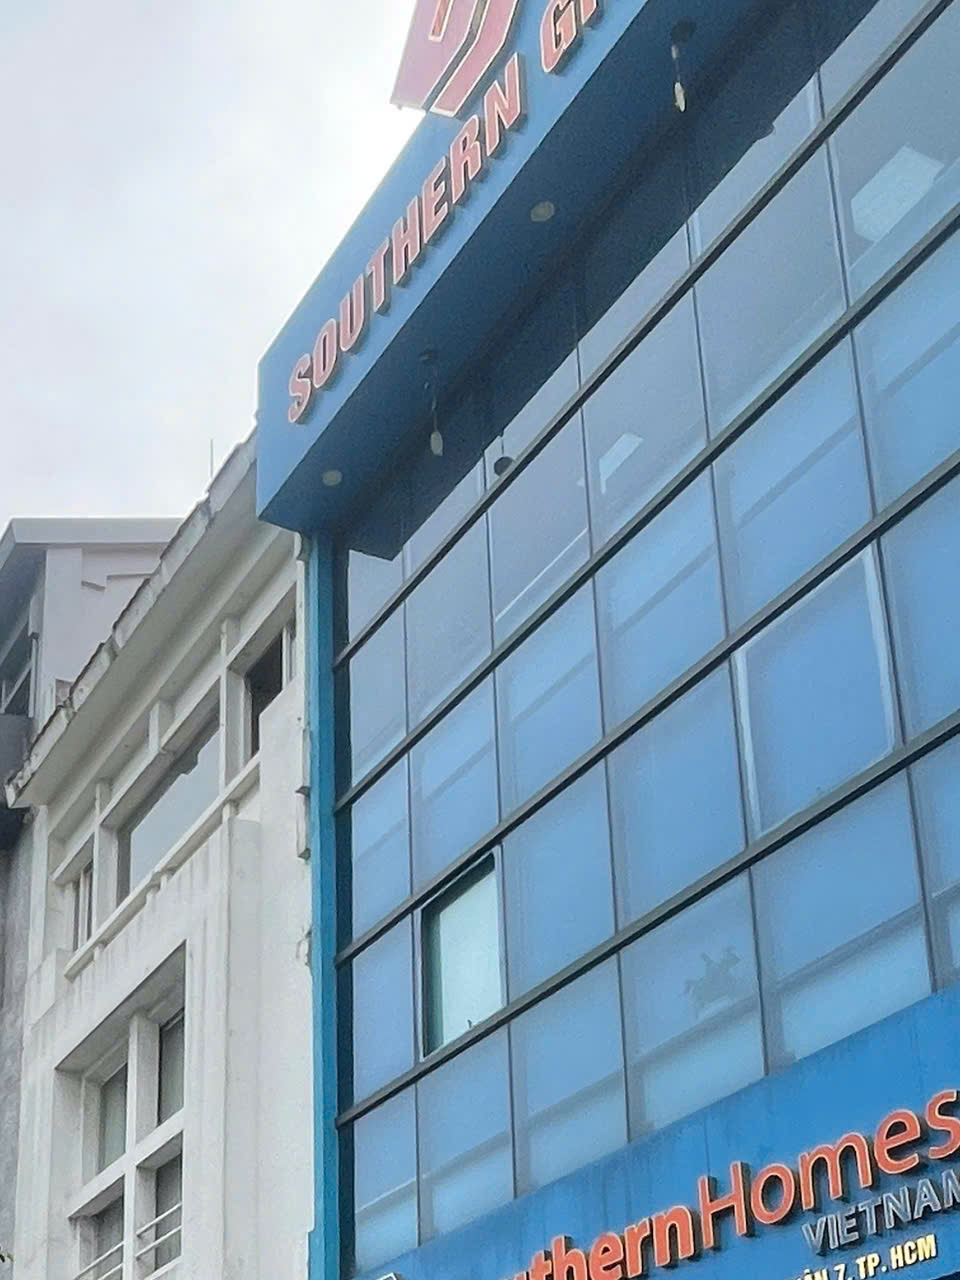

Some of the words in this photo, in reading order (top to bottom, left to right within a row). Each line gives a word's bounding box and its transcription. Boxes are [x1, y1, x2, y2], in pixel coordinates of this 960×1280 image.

[287, 51, 524, 424] SOUTHERN
[855, 1252, 888, 1280] TP.
[890, 1233, 939, 1270] HCM
